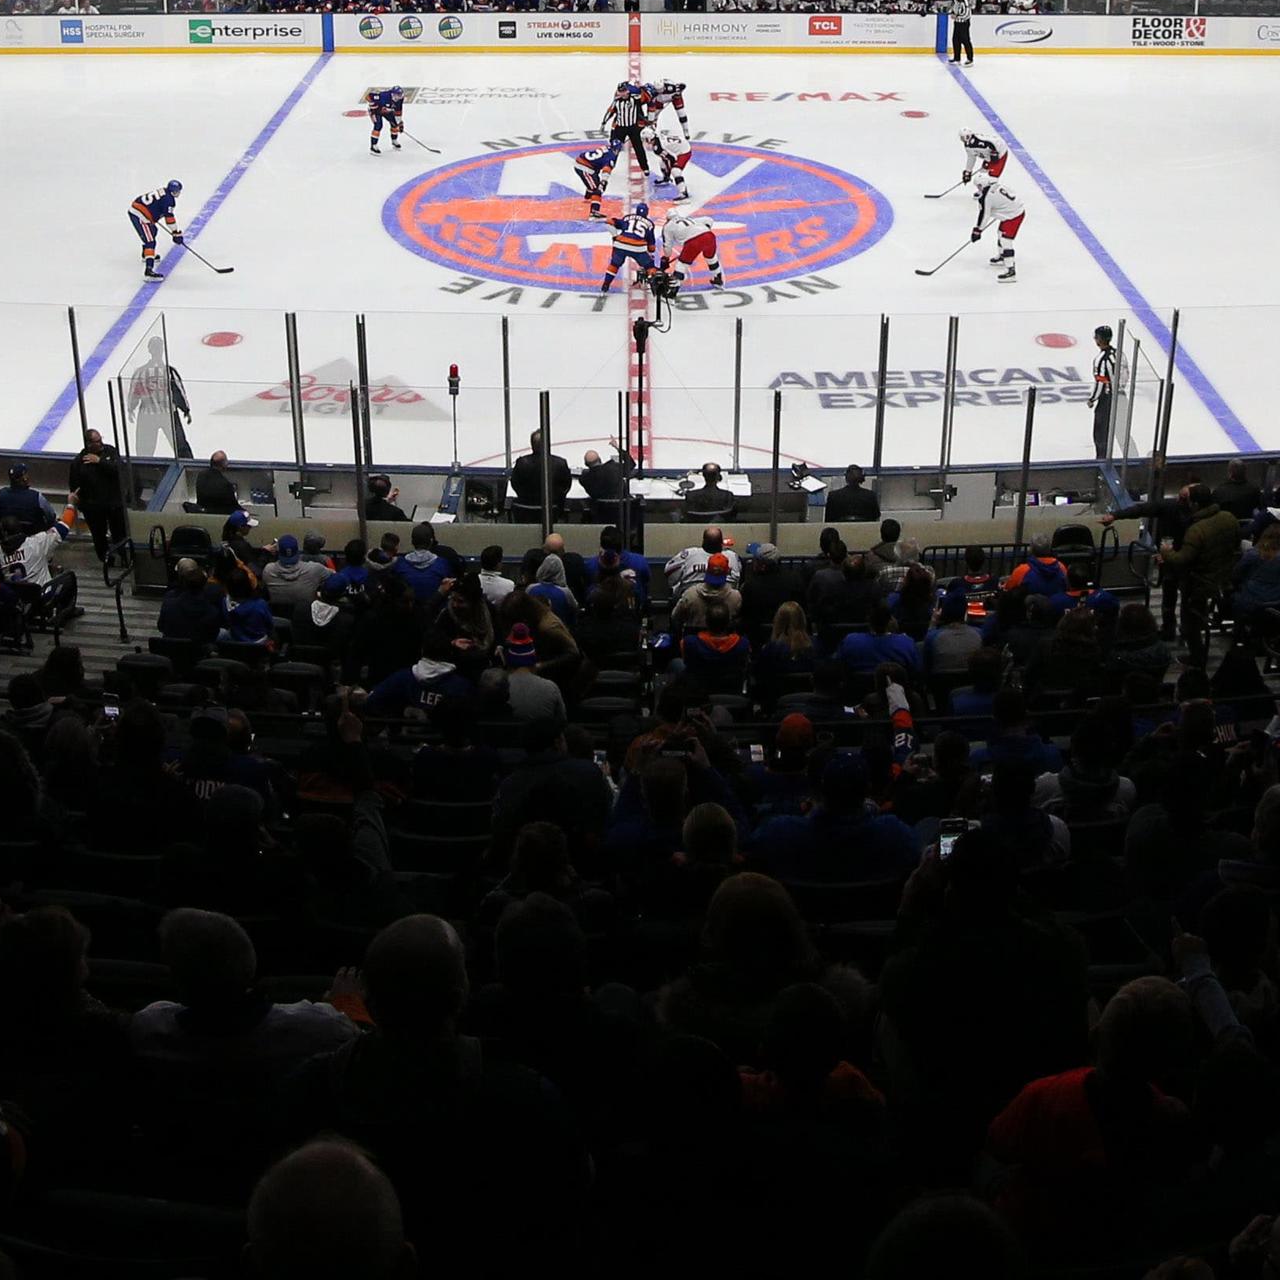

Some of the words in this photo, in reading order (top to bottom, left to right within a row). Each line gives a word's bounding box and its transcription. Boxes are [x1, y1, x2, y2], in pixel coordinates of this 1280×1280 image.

[527, 21, 560, 29] STREAM
[572, 21, 601, 29] GAMES
[683, 23, 748, 33] HARMONY
[812, 21, 838, 31] TCL
[1132, 18, 1183, 29] FLOOR
[62, 26, 82, 36] HSS
[85, 31, 113, 39] SPECIAL
[114, 31, 145, 39] SURGERY
[194, 24, 302, 40] enterprise
[1132, 29, 1183, 39] DECOR
[416, 93, 563, 101] Community
[709, 91, 907, 102] RE/MAX
[481, 129, 610, 151] NYCB
[626, 219, 646, 235] 15
[767, 366, 1082, 391] AMERICAN
[820, 384, 1093, 410] EXPRESS
